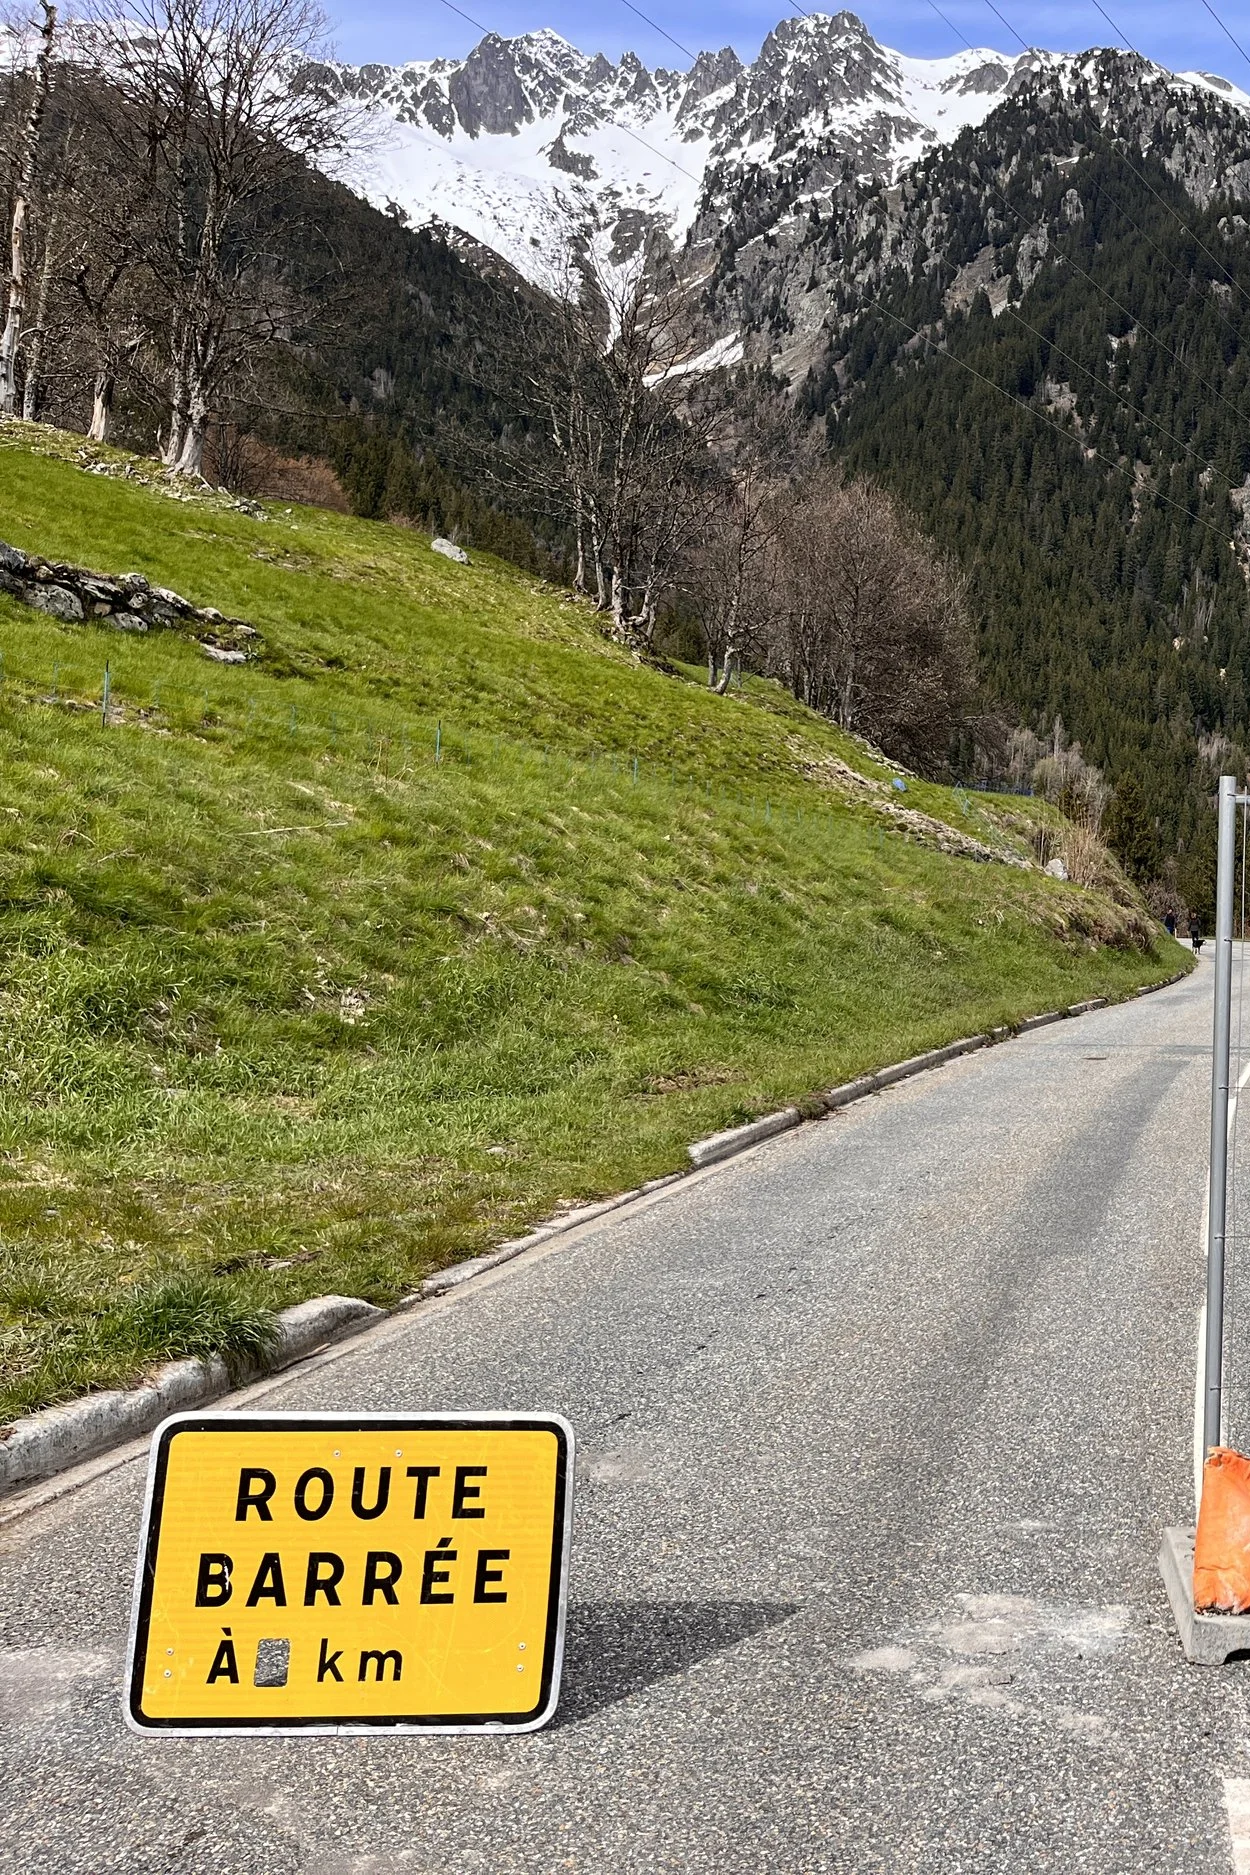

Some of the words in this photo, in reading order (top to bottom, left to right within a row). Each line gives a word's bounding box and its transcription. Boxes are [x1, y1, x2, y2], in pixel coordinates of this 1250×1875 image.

[235, 1466, 488, 1522] ROUTE
[194, 1537, 511, 1608] BARRÉE
[205, 1627, 240, 1684] À
[316, 1638, 403, 1683] km
